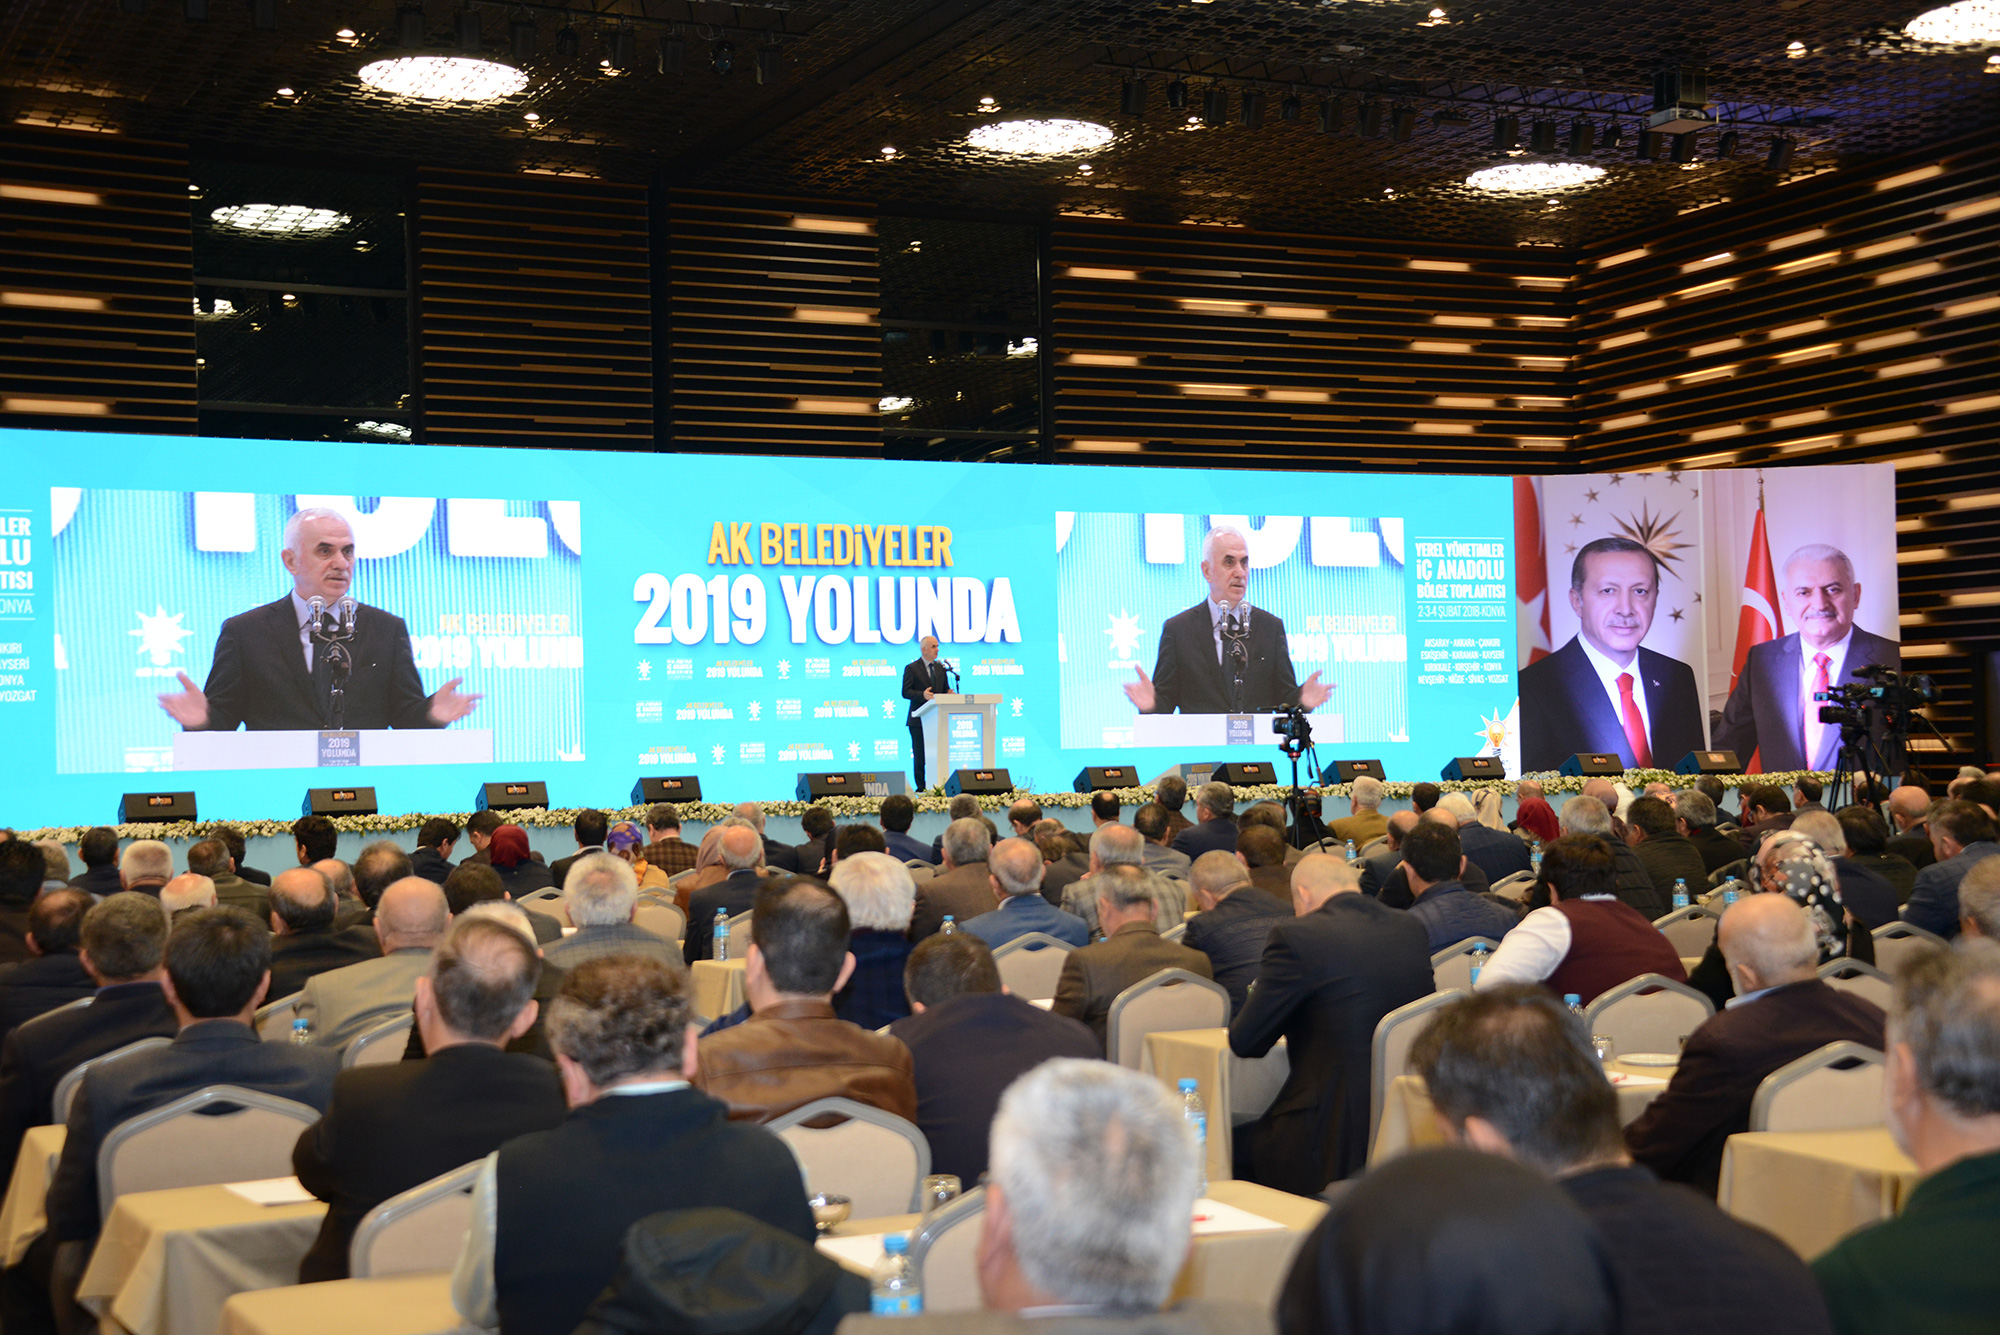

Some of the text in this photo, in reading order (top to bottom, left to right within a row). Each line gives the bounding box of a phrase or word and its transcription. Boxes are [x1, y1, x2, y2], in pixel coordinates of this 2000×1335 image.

[708, 521, 955, 567] AK BELEDİYELER
[1415, 541, 1504, 558] YEREL YÖNETİMLER
[1416, 559, 1504, 581] İÇ ANADOLU
[1417, 582, 1506, 599] BÖLGE TOPLANTISI
[633, 572, 1022, 645] 2019 YOLUNDA
[1418, 605, 1506, 619] 2-3-4 ŞUBAT 2018-KONYA
[439, 614, 464, 634] AK
[1424, 638, 1450, 647] AKSARAY
[1453, 638, 1475, 647] ANKARA
[410, 635, 472, 669] 2019
[1452, 650, 1479, 660] KARAMAN
[842, 666, 862, 677] 2019
[862, 666, 897, 677] YOLUNDA
[972, 665, 990, 676] 2019
[991, 665, 1024, 676] YOLUNDA
[1483, 662, 1502, 671] KONYA
[706, 667, 726, 678] 2019
[726, 667, 764, 678] YOLUNDA
[1487, 674, 1509, 684] YOZGAT
[676, 709, 696, 720] 2019
[696, 709, 734, 720] YOLUNDA
[814, 707, 833, 718] 2019
[834, 707, 869, 718] YOLUNDA
[956, 720, 973, 730] 2019
[1233, 720, 1248, 729] 2019
[952, 729, 978, 738] YOLUNDA
[328, 738, 350, 748] 2019
[321, 749, 357, 758] YOLUNDA
[639, 753, 697, 765] 2019 YOLUNDA
[778, 750, 797, 761] 2019
[797, 750, 834, 761] YOLUNDA
